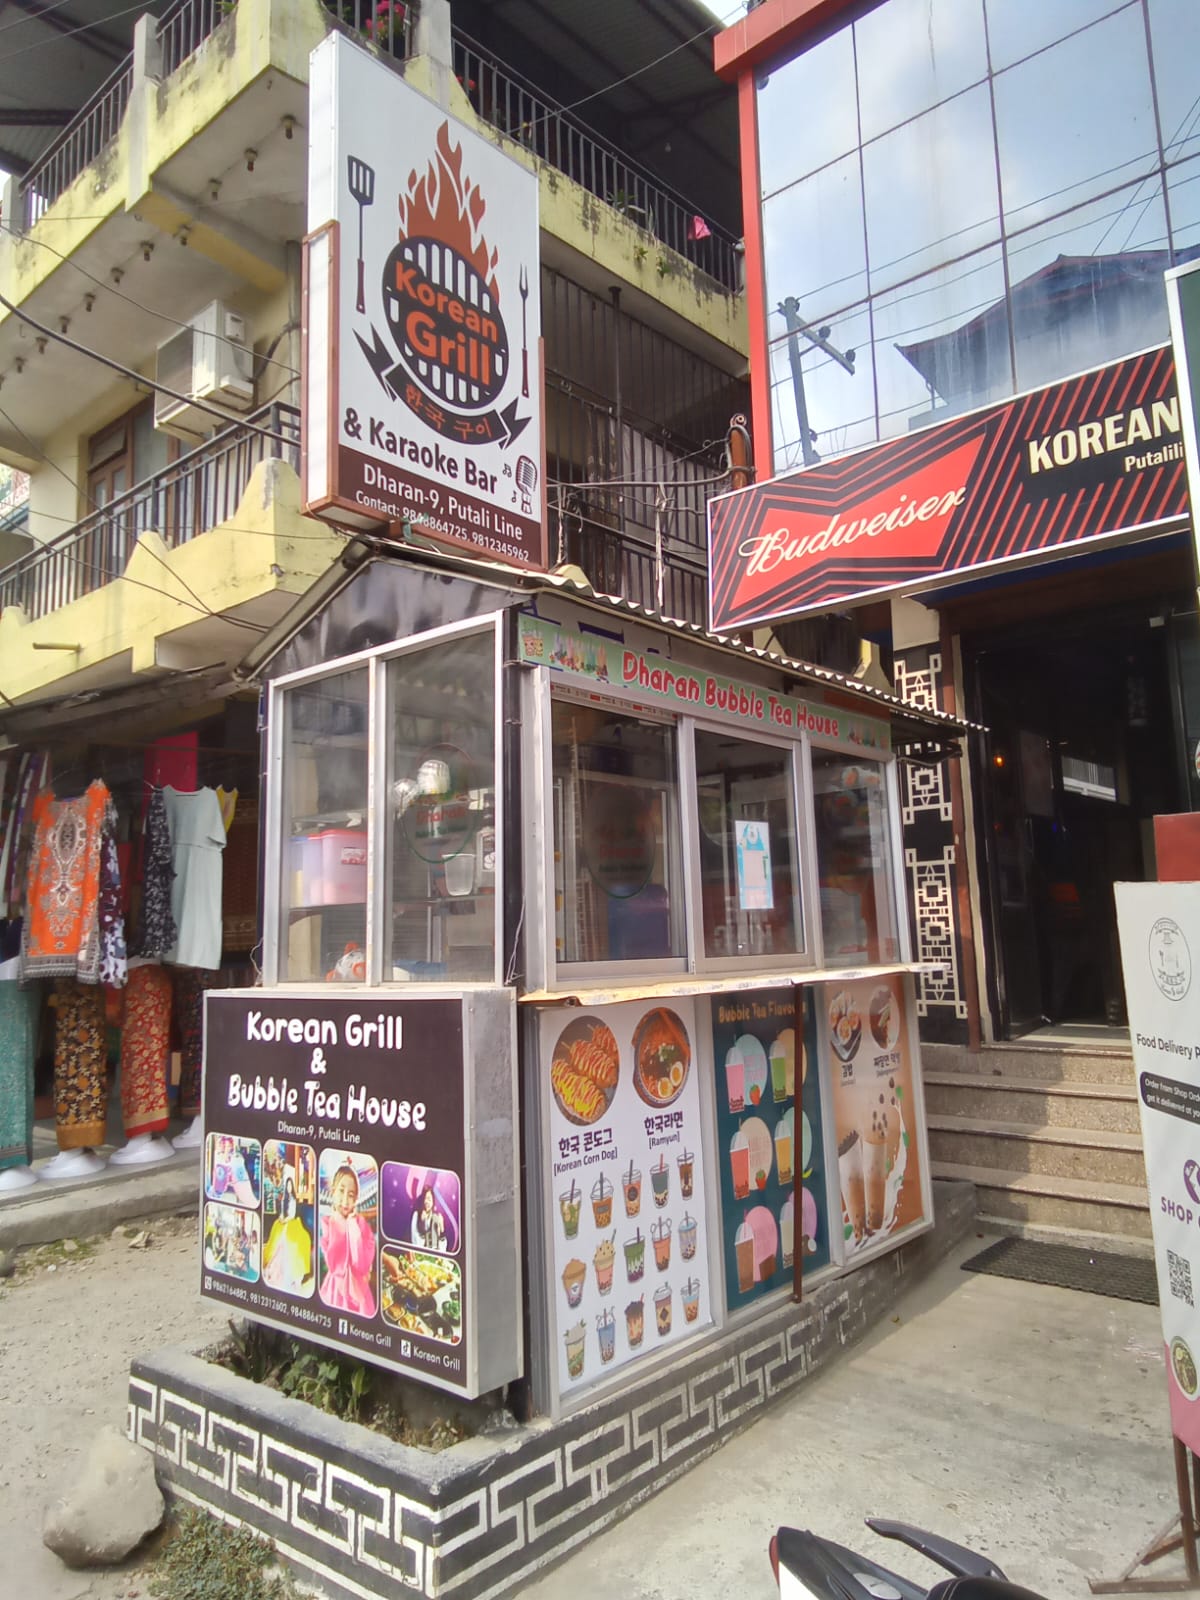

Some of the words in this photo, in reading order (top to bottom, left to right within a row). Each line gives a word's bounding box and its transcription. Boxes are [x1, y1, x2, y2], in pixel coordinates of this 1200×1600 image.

[395, 260, 498, 343] Korean
[406, 310, 490, 386] Grill
[406, 383, 446, 431] 한국
[453, 417, 492, 440] 구이
[343, 407, 362, 441] &
[369, 416, 459, 479] Karaoke
[465, 457, 498, 495] Bar
[1028, 396, 1181, 474] KOREAN
[364, 463, 444, 515] Dharan-9,
[448, 495, 490, 529] Putali
[494, 513, 523, 540] Line
[355, 490, 400, 517] Contact:
[472, 532, 529, 562] 9812345962
[738, 486, 967, 577] Budweiser
[622, 651, 700, 702] Dharan
[705, 678, 763, 719] Bubble
[767, 696, 793, 727] Tea
[797, 703, 839, 737] House
[247, 1010, 338, 1045] Korean
[345, 1014, 403, 1050] Grill
[719, 1005, 750, 1024] Bubble
[752, 1002, 767, 1018] Tea
[310, 1047, 327, 1074] &
[1136, 1033, 1156, 1049] Food
[1158, 1038, 1193, 1060] Delivery
[227, 1074, 298, 1114] Bubble
[304, 1080, 341, 1120] Tea
[347, 1084, 426, 1131] House
[277, 1120, 317, 1140] Dharan-9,
[318, 1126, 341, 1141] Putali
[343, 1129, 361, 1144] Line
[644, 1111, 684, 1136] 한국라면
[649, 1131, 680, 1149] [Ramyun]
[558, 1135, 580, 1159] 한국
[583, 1127, 613, 1152] 콘도그
[553, 1158, 582, 1177] [Korean
[583, 1154, 600, 1166] Corn
[601, 1146, 618, 1161] Dog]
[1160, 1196, 1193, 1225] SHOP
[349, 1323, 375, 1341] Korean
[375, 1333, 392, 1348] Grill
[413, 1346, 441, 1364] Korean
[443, 1354, 460, 1371] Grill
